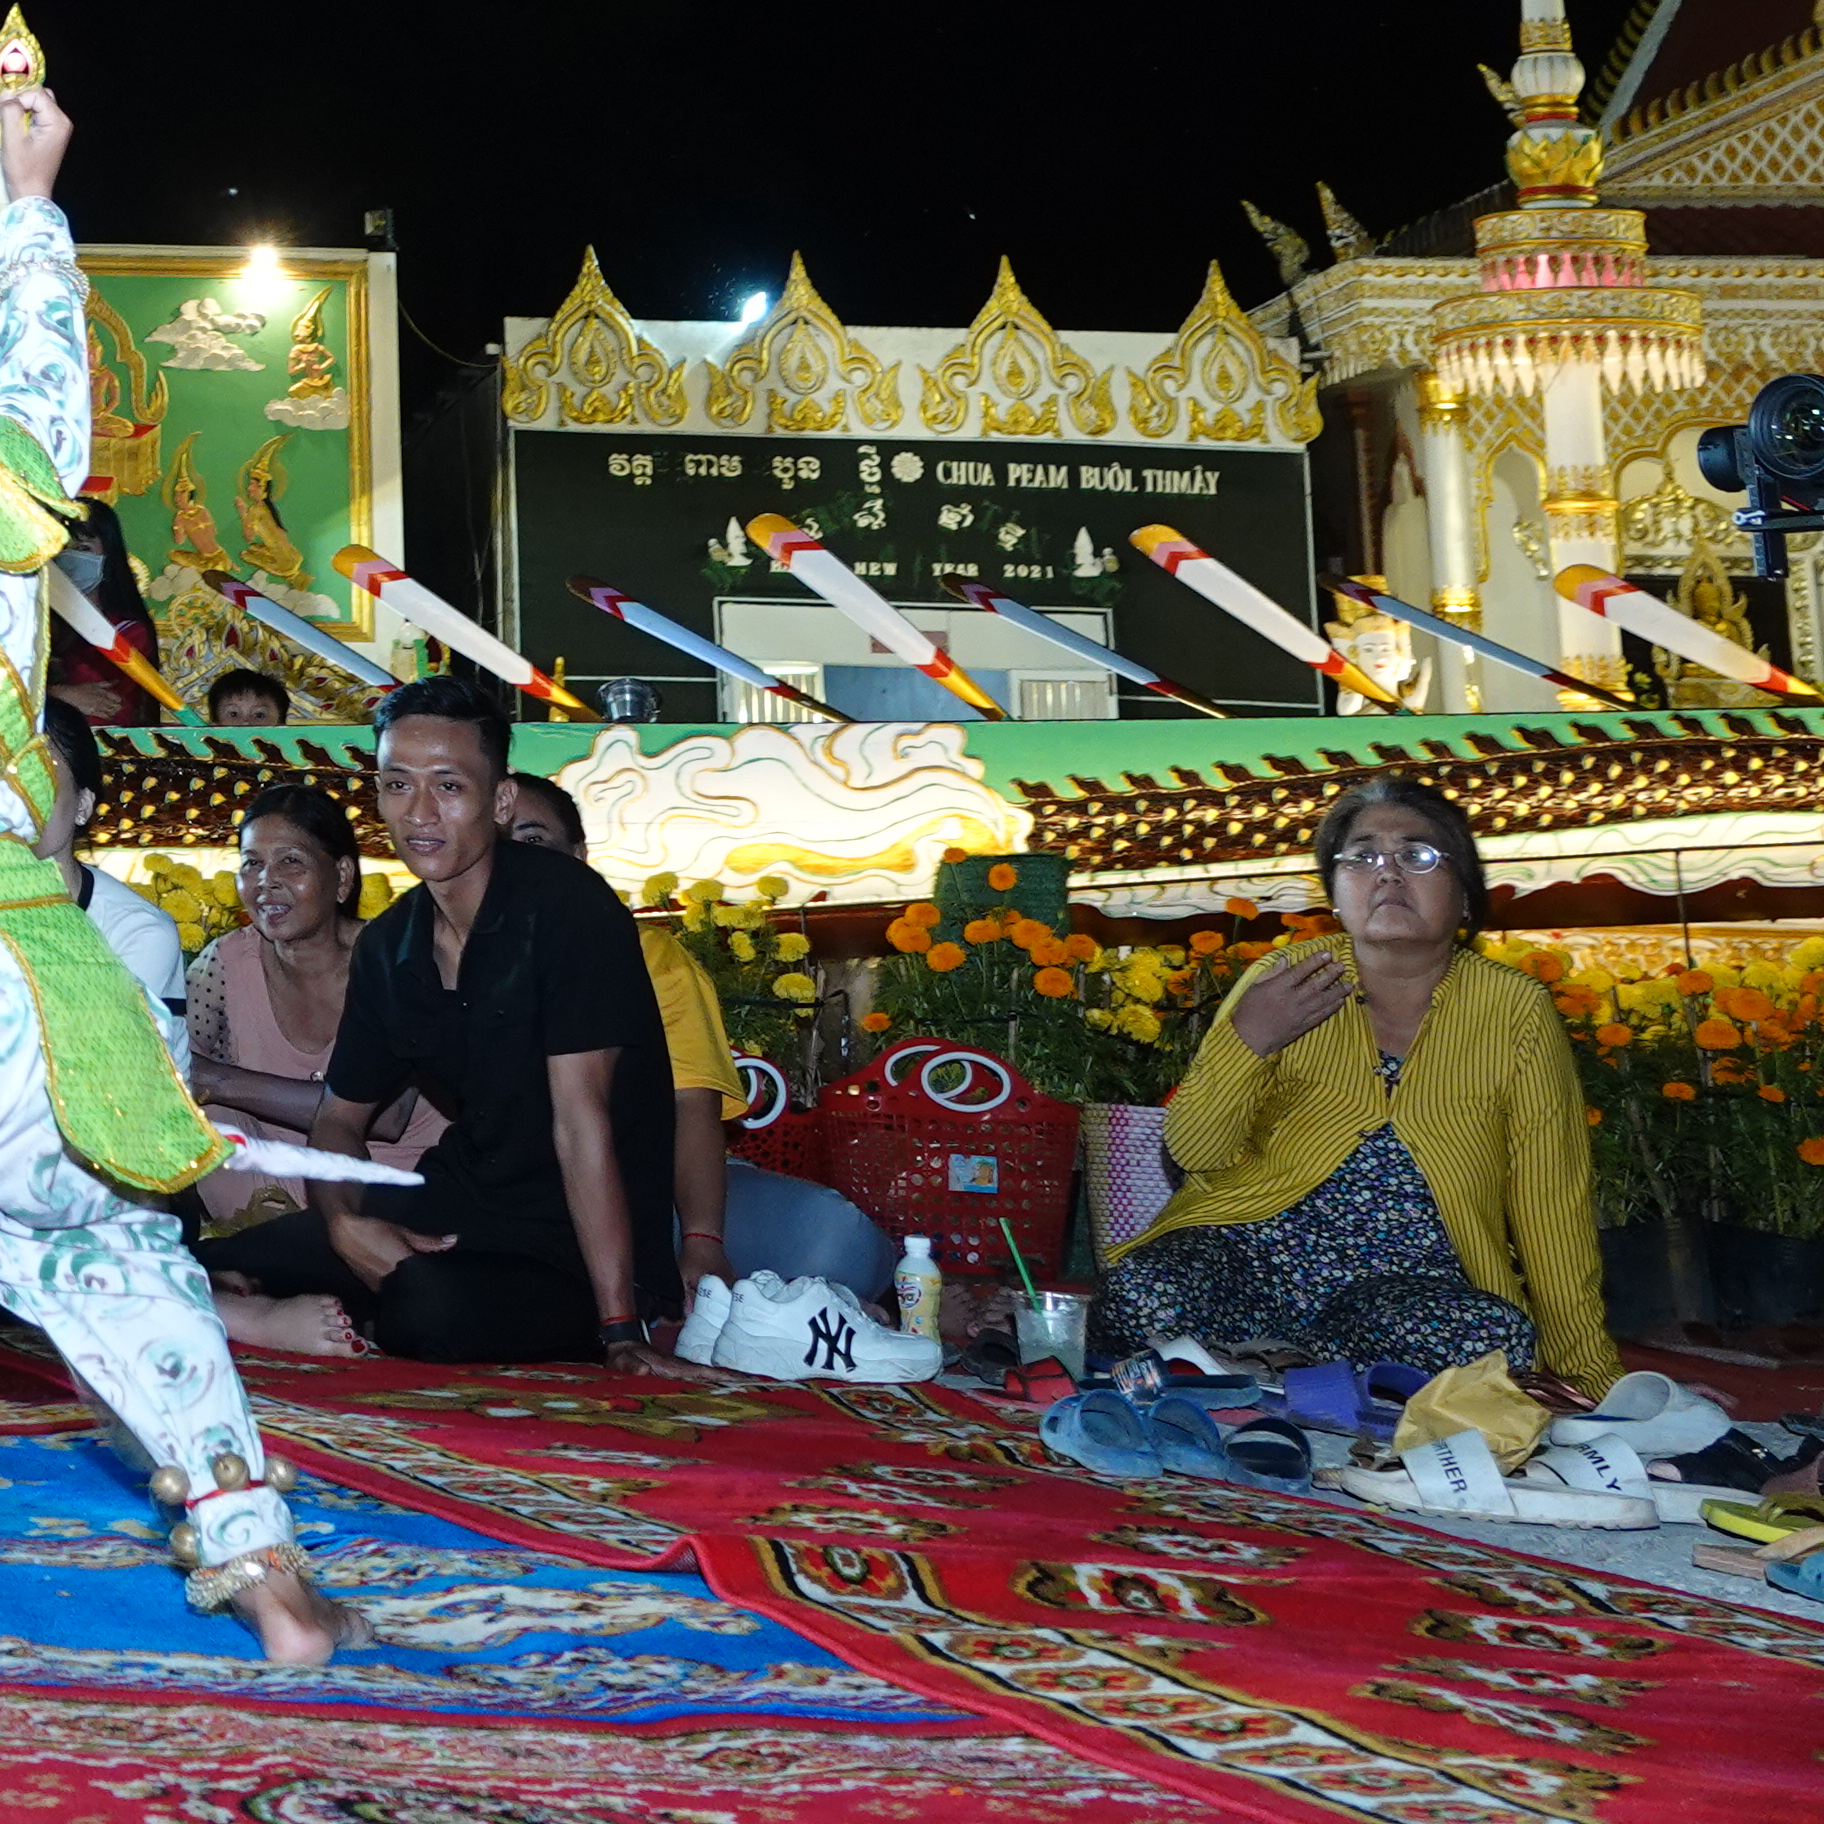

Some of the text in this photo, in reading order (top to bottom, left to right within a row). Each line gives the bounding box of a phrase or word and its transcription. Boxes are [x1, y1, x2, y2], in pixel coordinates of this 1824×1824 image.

[936, 460, 996, 487] CHUA
[1007, 463, 1070, 490] PEAM
[1079, 462, 1139, 493] BUÔL
[1002, 563, 1055, 579] 2021
